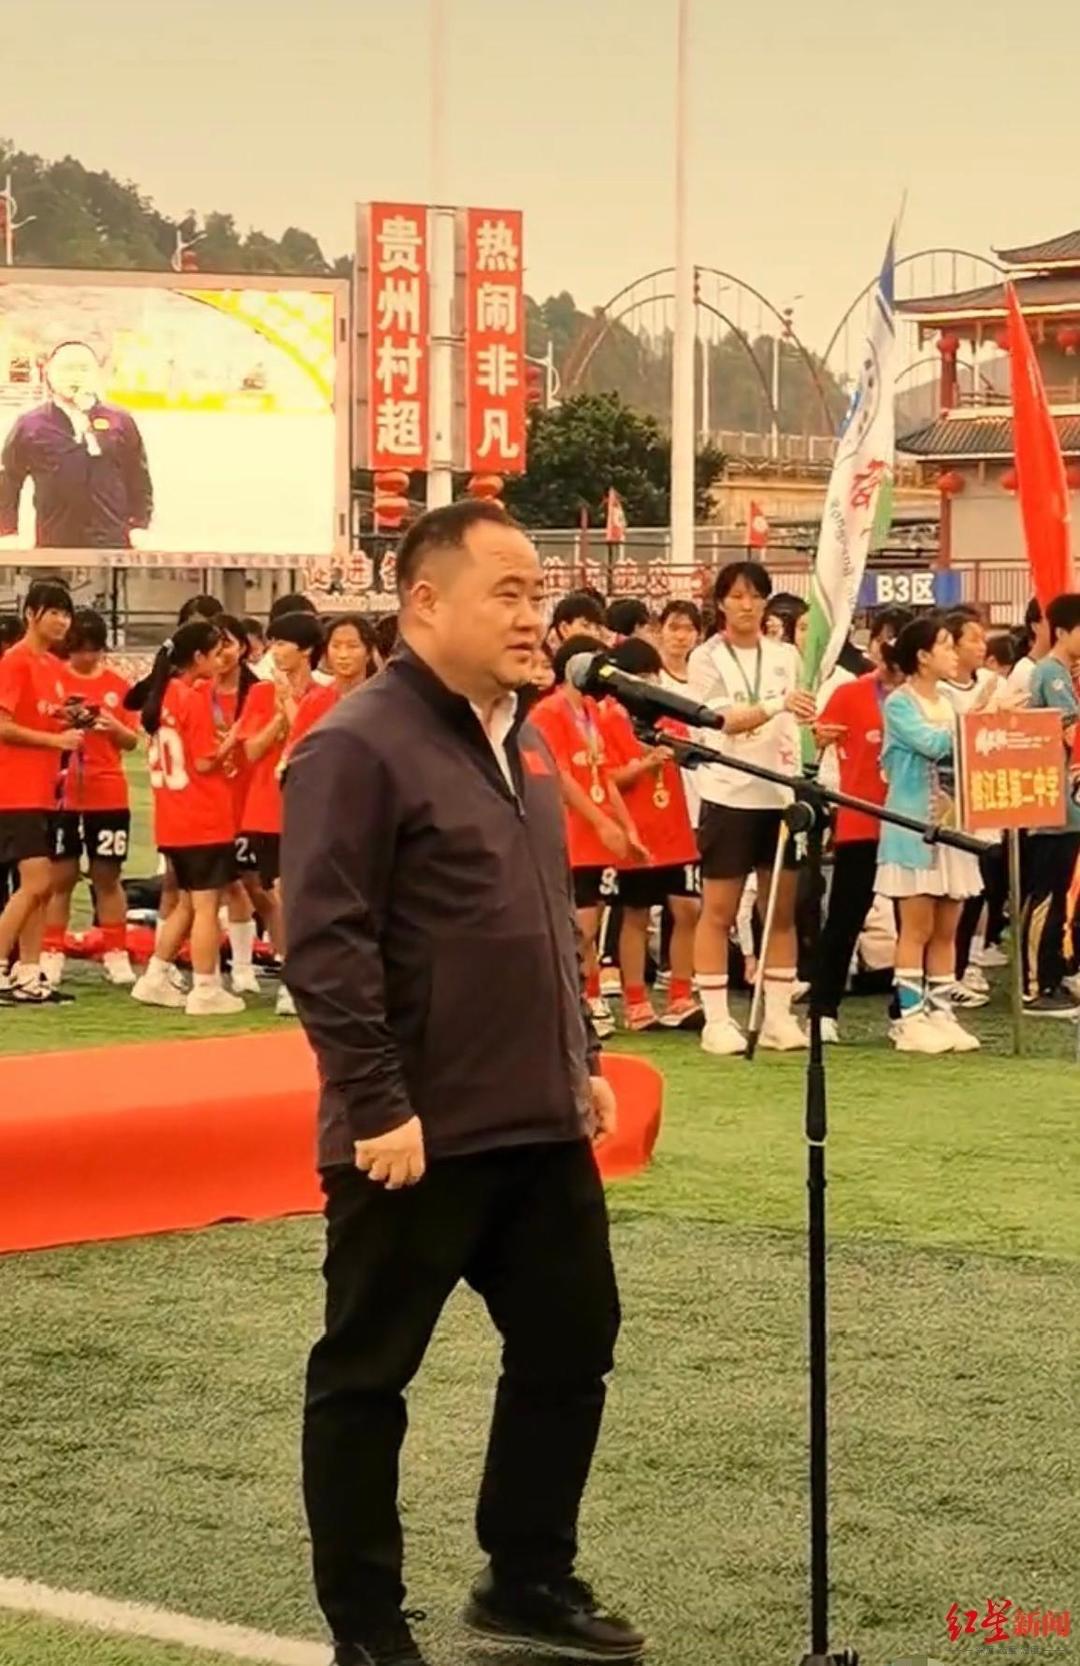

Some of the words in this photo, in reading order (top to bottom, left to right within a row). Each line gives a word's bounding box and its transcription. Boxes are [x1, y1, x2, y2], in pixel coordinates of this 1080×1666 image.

[375, 214, 423, 456] 贵州村超
[475, 218, 519, 459] 热闹非凡
[876, 572, 935, 605] B3区
[96, 829, 127, 856] 26
[235, 837, 257, 863] 2
